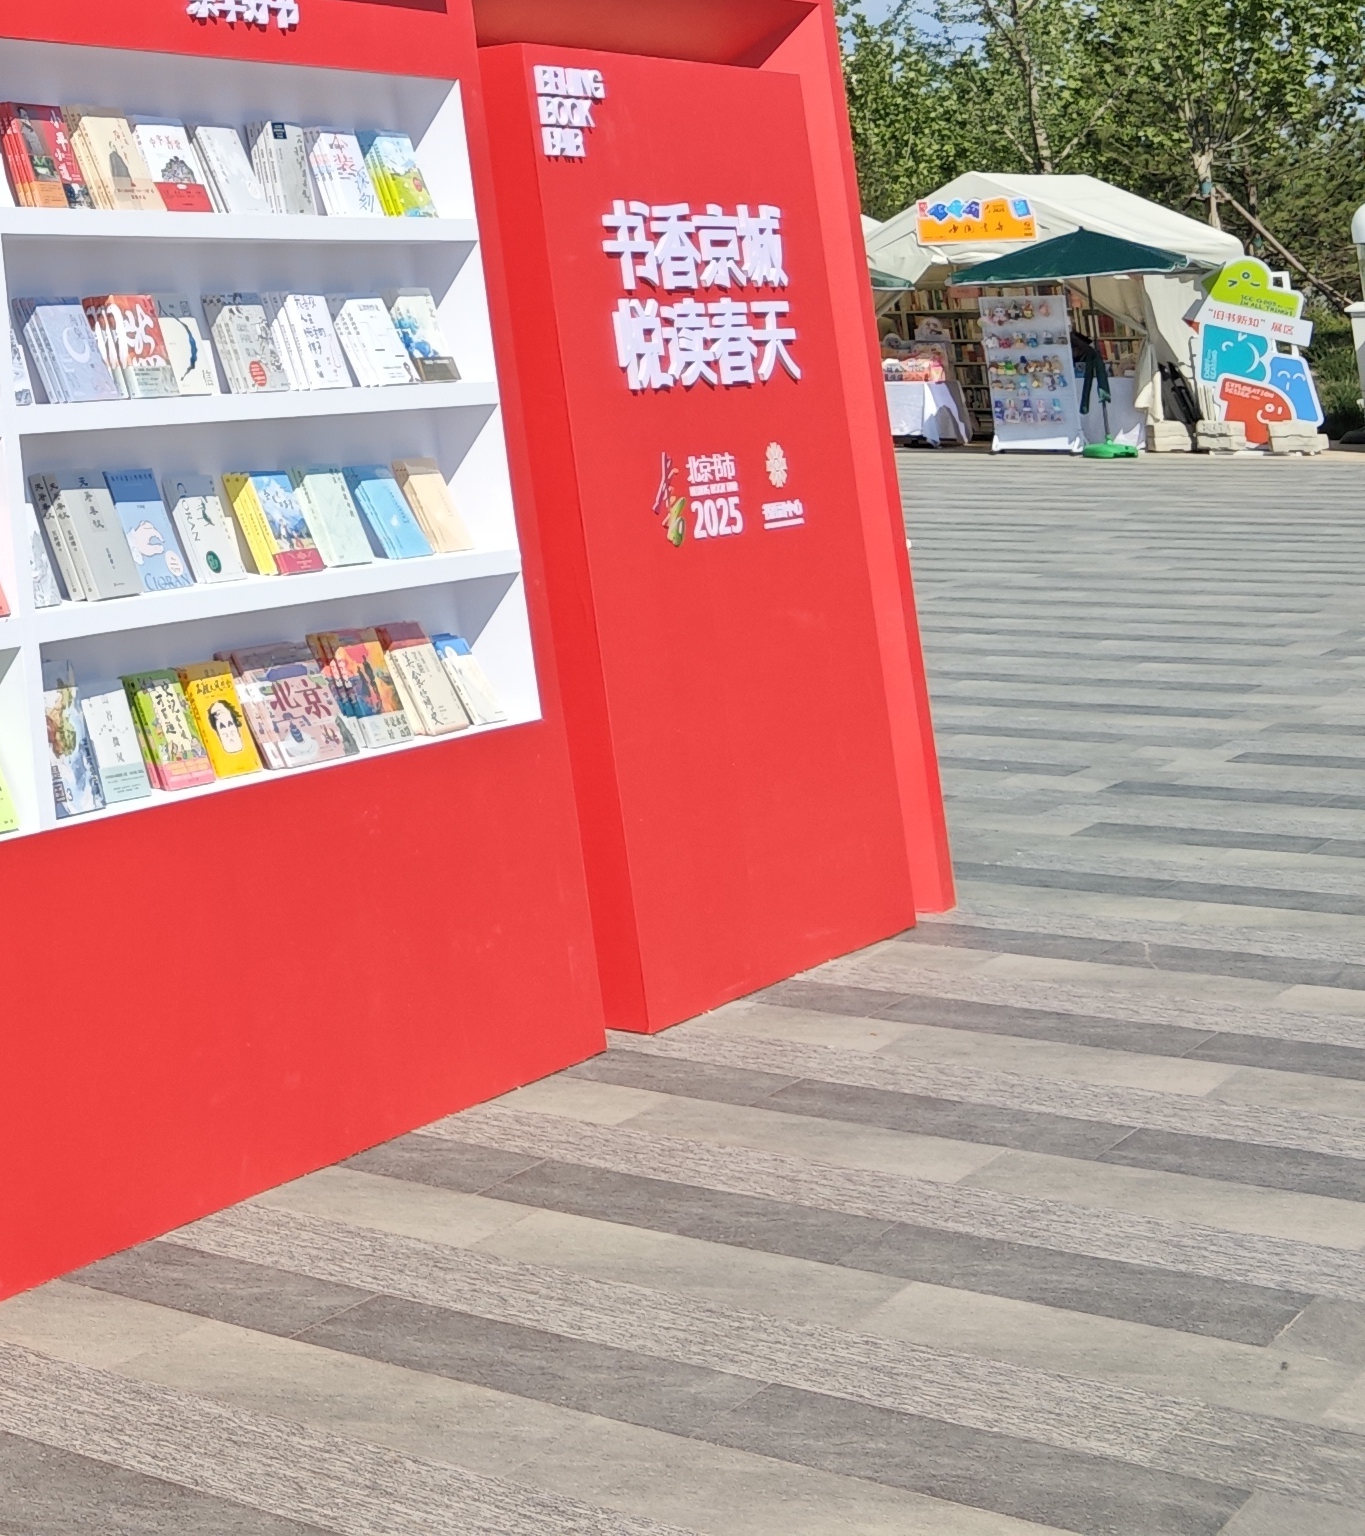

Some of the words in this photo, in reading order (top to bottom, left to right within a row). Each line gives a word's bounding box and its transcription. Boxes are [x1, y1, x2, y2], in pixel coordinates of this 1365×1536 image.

[533, 64, 606, 100] BEIJING
[537, 96, 596, 128] BOOK
[49, 109, 72, 182] 小平小道
[540, 127, 586, 158] FAIR
[601, 199, 789, 291] 书香京城
[612, 297, 802, 391] 悦读春天
[691, 496, 744, 539] 2025
[270, 678, 333, 719] 北京
